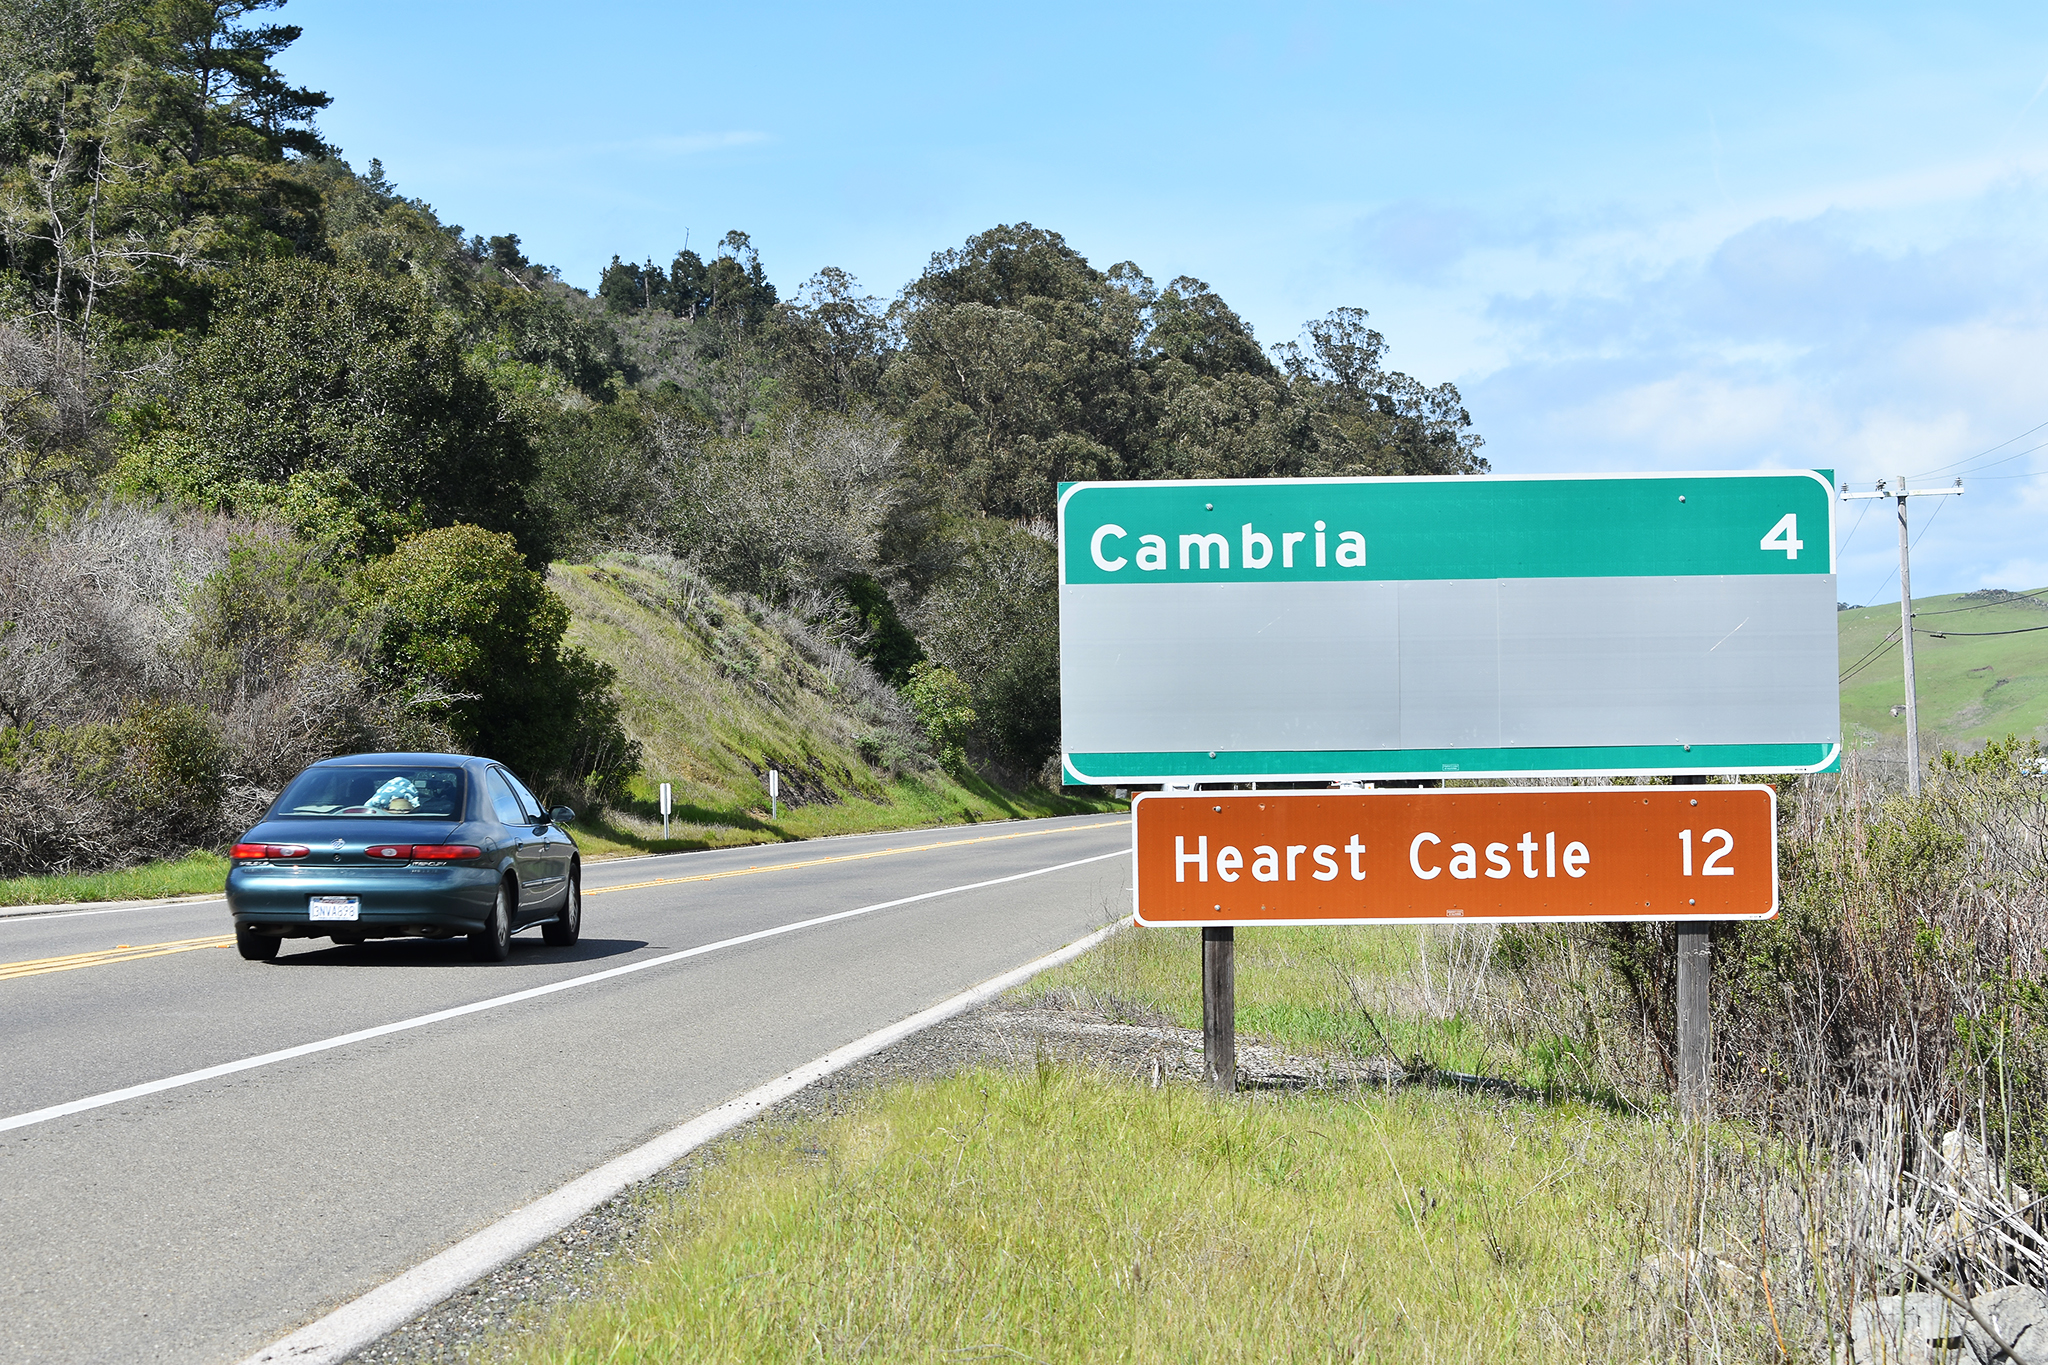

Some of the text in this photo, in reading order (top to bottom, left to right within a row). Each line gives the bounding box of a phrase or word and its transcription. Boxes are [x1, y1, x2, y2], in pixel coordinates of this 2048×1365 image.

[1090, 513, 1804, 572] Cambria 4
[1175, 828, 1735, 883] Hearst Castle 12
